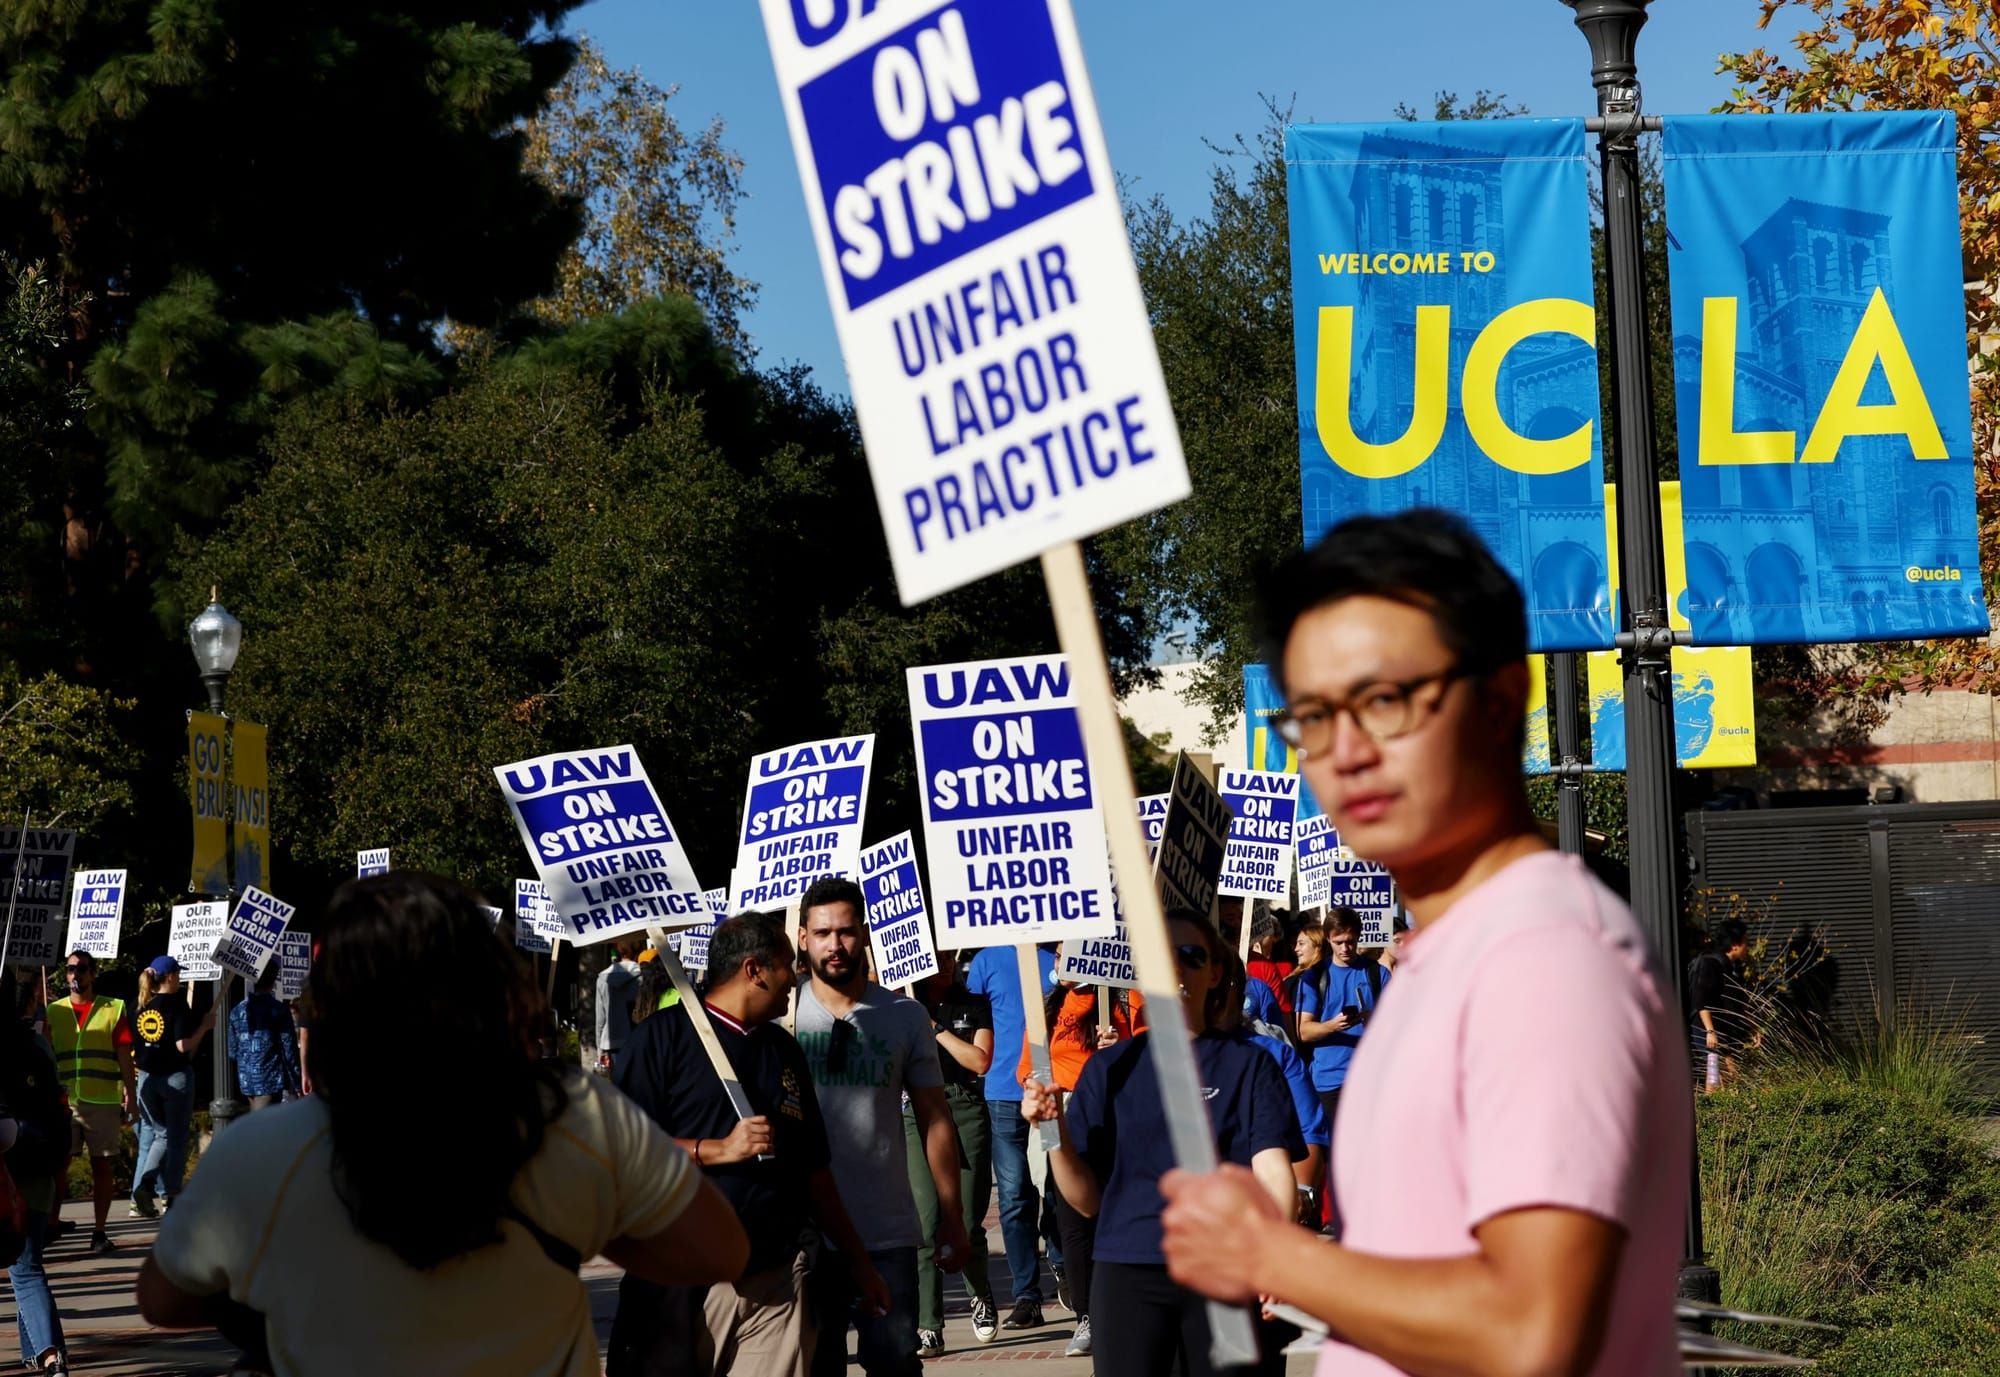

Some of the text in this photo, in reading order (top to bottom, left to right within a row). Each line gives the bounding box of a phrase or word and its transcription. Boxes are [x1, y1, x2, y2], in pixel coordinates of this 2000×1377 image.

[873, 9, 981, 141] ON
[833, 80, 1083, 281] STRIKE
[1318, 251, 1495, 274] WELCOME TO
[891, 243, 1078, 378] UNFAIR
[919, 330, 1089, 456] LABOR
[903, 394, 1156, 554] PRACTICE
[1905, 565, 1962, 583] @ucla
[923, 660, 1073, 709] UAW
[972, 715, 1035, 761] ON
[1718, 725, 1750, 736] @ucla
[194, 732, 220, 774] GO
[759, 740, 866, 777] UAW
[504, 751, 632, 794] UAW
[1226, 772, 1296, 795] UAW
[783, 772, 828, 801] ON
[933, 759, 1087, 810] STRIKE
[563, 789, 617, 820] ON
[1177, 759, 1232, 840] UAW
[1242, 797, 1272, 818] ON
[749, 795, 857, 836] STRIKE
[539, 813, 666, 857] STRIKE
[957, 821, 1073, 857] UNFAIR
[1229, 816, 1291, 840] TRIKE
[758, 831, 839, 862] UNFAIR
[1183, 820, 1206, 865] ON
[1226, 843, 1280, 861] UNFAIR
[1309, 835, 1326, 852] ON
[13, 856, 43, 877] ON
[360, 851, 387, 866] UAW
[567, 848, 668, 884] UNFAIR
[758, 853, 832, 882] LABOR
[860, 838, 908, 874] UAW
[1300, 847, 1339, 870] STRIKE
[1334, 861, 1388, 874] UAW
[86, 873, 122, 885] UAW
[967, 856, 1071, 892] LABOR
[1163, 837, 1213, 914] STRIKE
[1228, 859, 1275, 877] LABOR
[0, 878, 62, 899] TRIKE
[519, 882, 540, 893] UA
[581, 871, 673, 906] LABOR
[879, 870, 901, 896] ON
[1218, 874, 1286, 893] PRACTICE
[1307, 879, 1329, 893] LABO
[1349, 877, 1373, 891] ON
[92, 889, 109, 902] ON
[247, 890, 291, 917] UAW
[870, 887, 921, 925] STRIKE
[1302, 890, 1328, 905] PRACT
[1333, 891, 1389, 906] STRIKE
[79, 902, 117, 917] STRIKE
[186, 905, 212, 917] OUR
[251, 909, 272, 928] ON
[518, 908, 536, 918] STR
[571, 892, 703, 935] PRACTICE
[946, 889, 1100, 929] PRACTICE
[1359, 911, 1382, 921] FAIR
[80, 921, 108, 930] UNFAIR
[172, 928, 224, 940] CONDITIONS
[177, 917, 222, 930] WORKING
[232, 917, 277, 946] STRIKE
[538, 922, 567, 934] PRACTI
[686, 924, 715, 935] STRI
[880, 919, 920, 948] UNFAIR
[72, 942, 109, 952] PRACTICE
[79, 932, 105, 941] LABOR
[181, 942, 210, 953] YOUR
[231, 934, 264, 957] UNFAIR
[1359, 933, 1389, 943] CTICE
[0, 941, 53, 958] CTICE
[227, 942, 258, 965] LABOR
[286, 945, 300, 955] ON
[683, 956, 709, 966] PRACT
[690, 947, 709, 957] LAB
[886, 938, 921, 965] LABOR
[1081, 940, 1131, 961] LABOR
[216, 950, 260, 978] PRACTICE
[282, 956, 309, 968] TRIKE
[882, 952, 934, 985] PRACTICE
